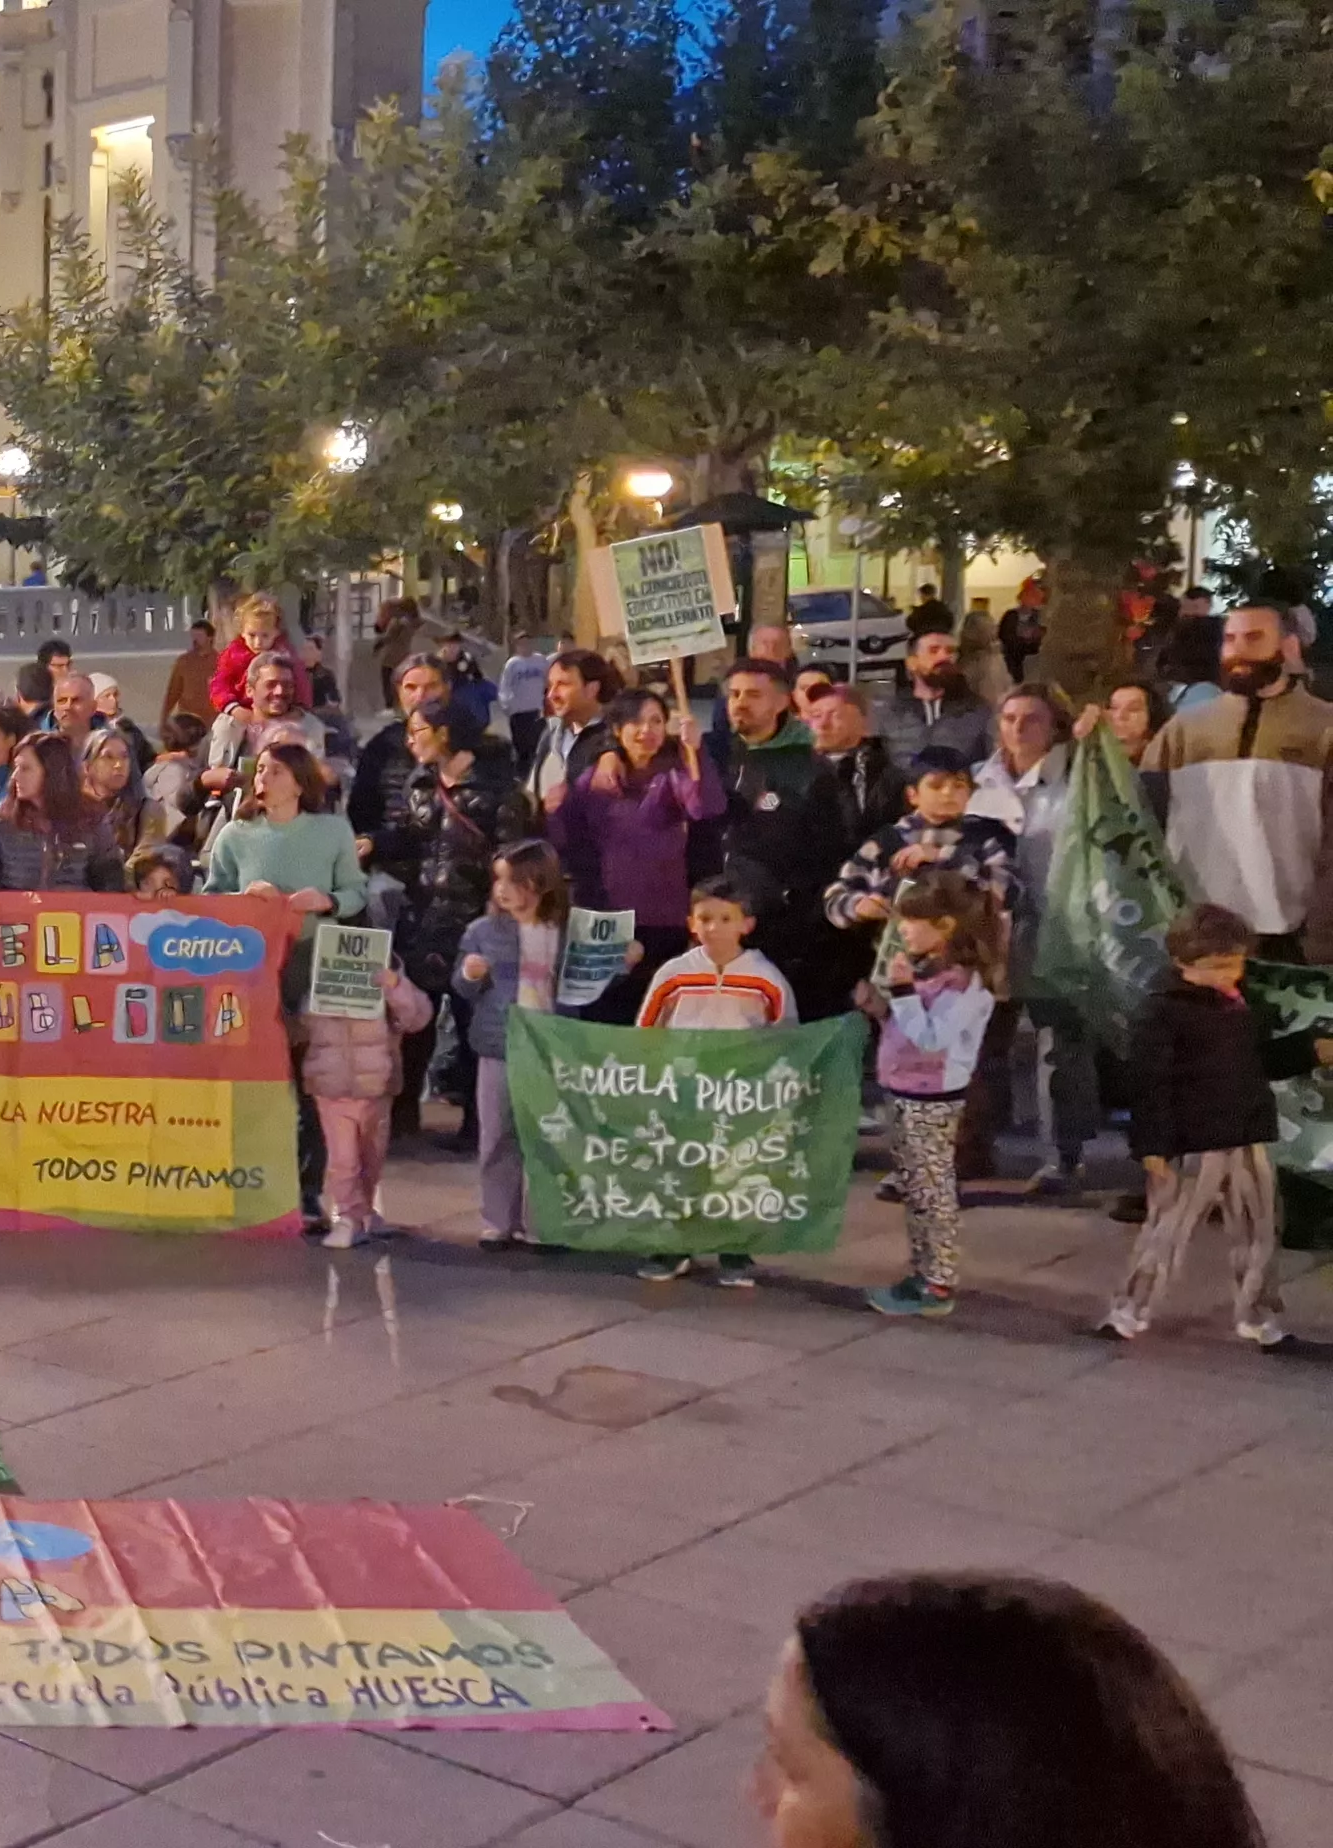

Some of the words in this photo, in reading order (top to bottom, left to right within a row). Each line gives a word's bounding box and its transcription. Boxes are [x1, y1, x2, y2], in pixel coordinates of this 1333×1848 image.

[638, 539, 682, 577] NO!
[162, 935, 245, 958] CRÍTICA
[338, 933, 370, 959] NO!
[0, 1100, 27, 1122] LA
[37, 1100, 158, 1126] NUESTRA
[586, 1136, 630, 1165] DE
[32, 1156, 119, 1183] TODOS
[126, 1161, 265, 1191] PINTAMOS
[675, 1187, 809, 1222] TOD@S
[233, 1638, 555, 1670] PINTAMOS
[344, 1674, 532, 1710] HUESCA
